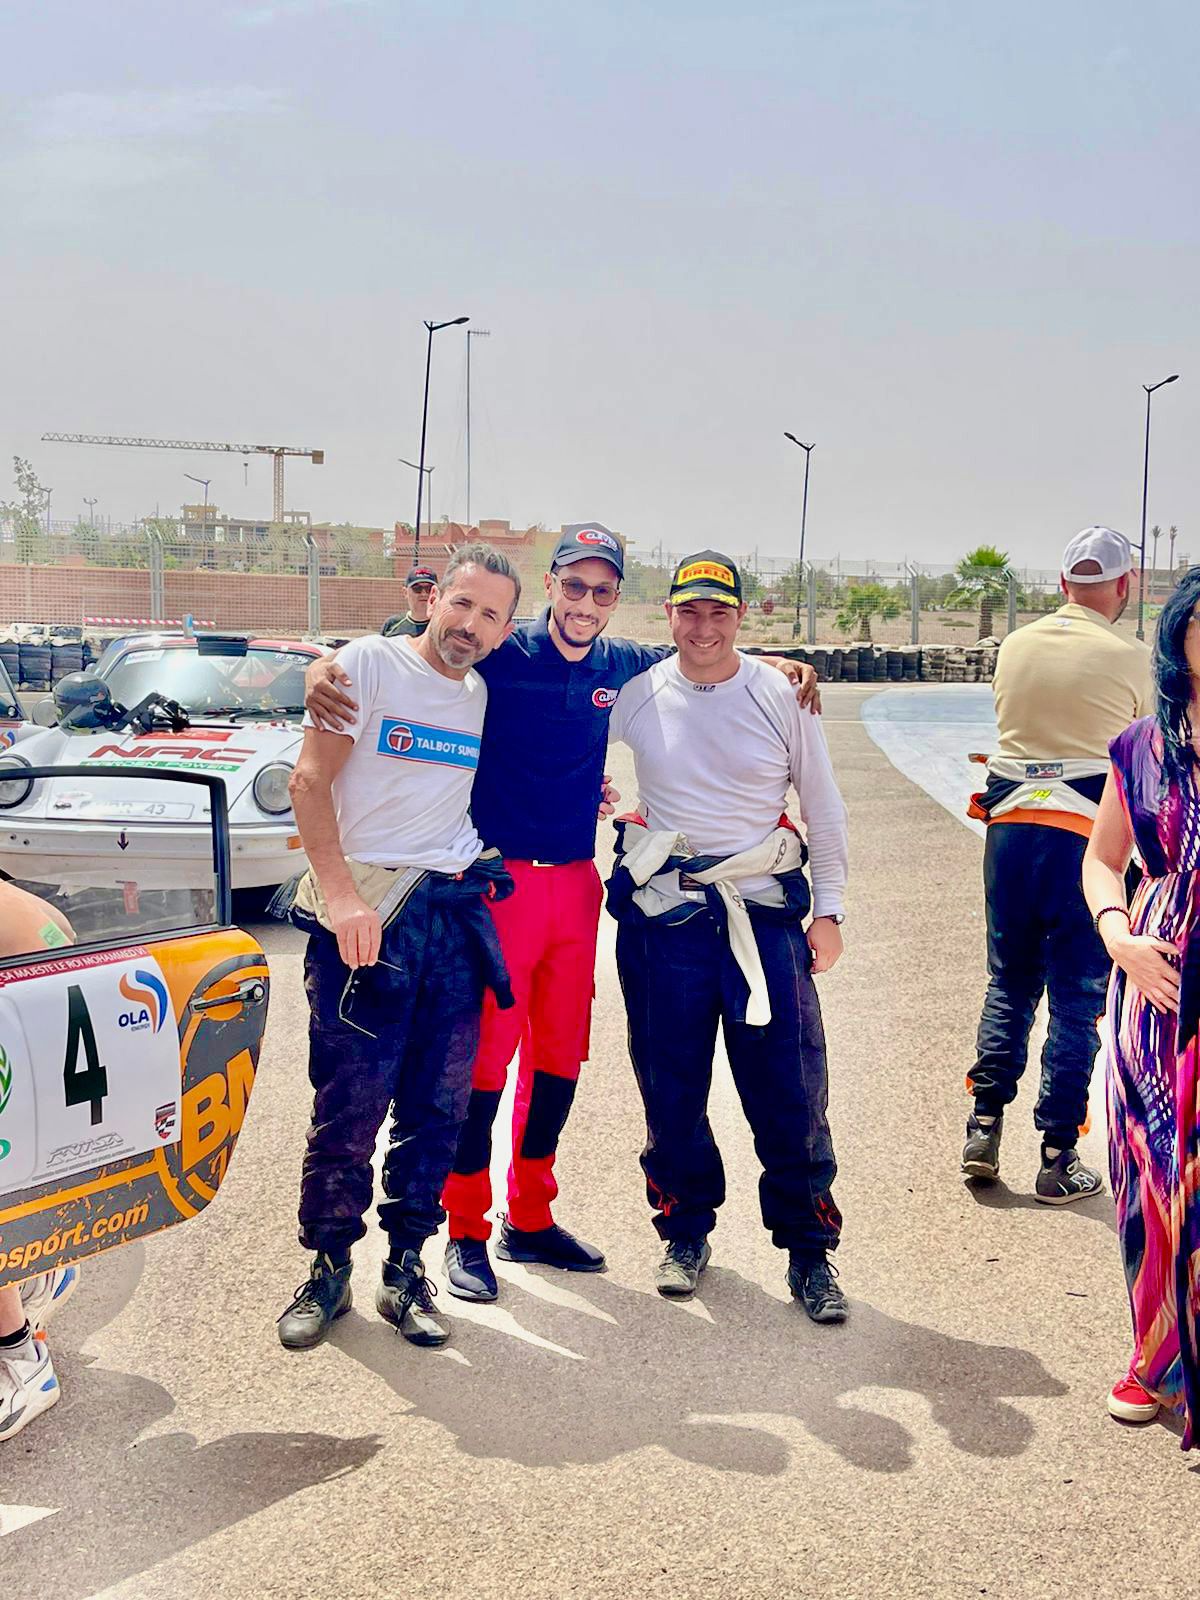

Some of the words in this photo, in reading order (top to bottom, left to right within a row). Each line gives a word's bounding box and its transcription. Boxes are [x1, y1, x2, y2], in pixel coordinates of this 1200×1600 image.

[681, 564, 731, 582] PIRELLI
[88, 745, 257, 763] NAC
[416, 737, 457, 754] TALBOT
[55, 961, 67, 973] LE
[67, 958, 83, 970] ROI
[83, 949, 137, 967] MOHAMMED
[118, 1009, 149, 1028] OLA
[63, 984, 108, 1126] 4
